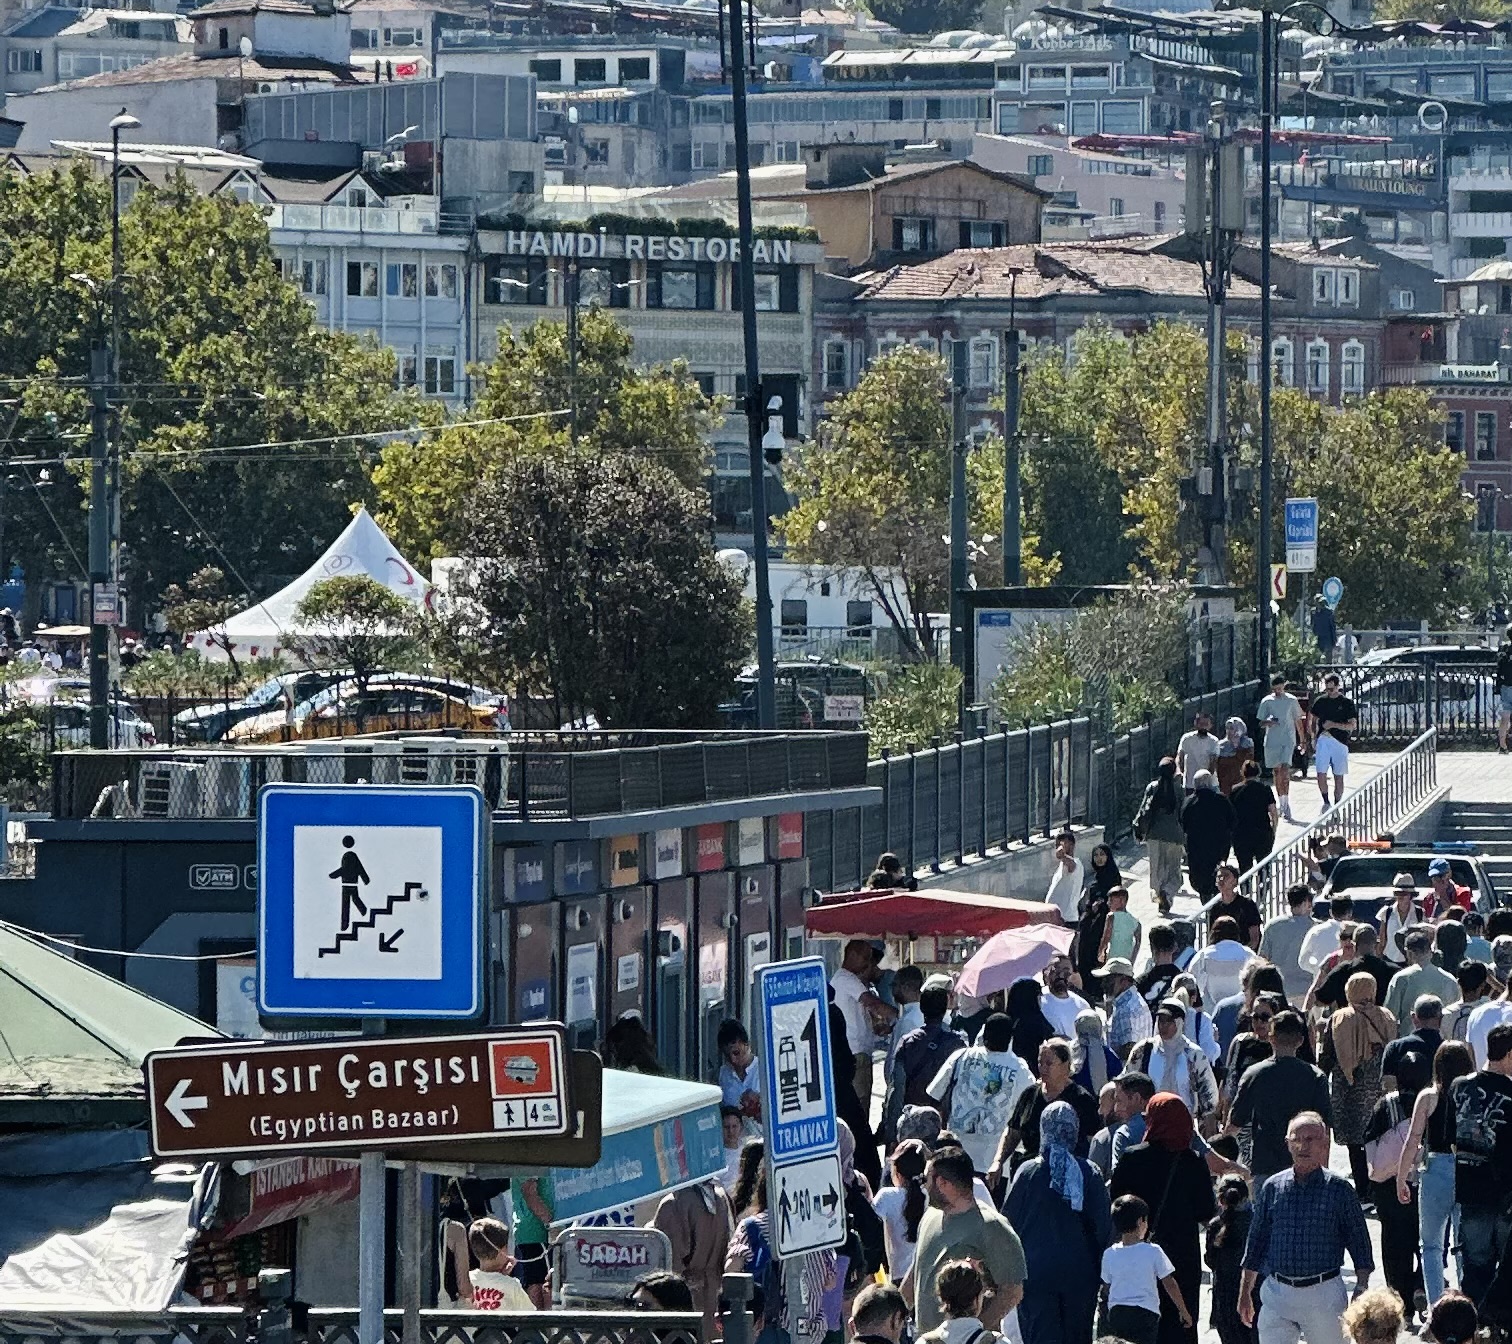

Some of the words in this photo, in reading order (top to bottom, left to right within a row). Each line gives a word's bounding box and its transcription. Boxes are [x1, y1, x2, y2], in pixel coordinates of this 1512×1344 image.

[507, 226, 607, 257] HAMDİ
[222, 1060, 322, 1097] Mısır
[337, 1054, 480, 1099] Çarşısı
[249, 1108, 364, 1142] (Egyptian
[371, 1104, 460, 1131] Bazaar)
[530, 1103, 539, 1123] 4
[778, 1118, 829, 1151] TRAMVAY
[580, 1243, 647, 1264] SABAH
